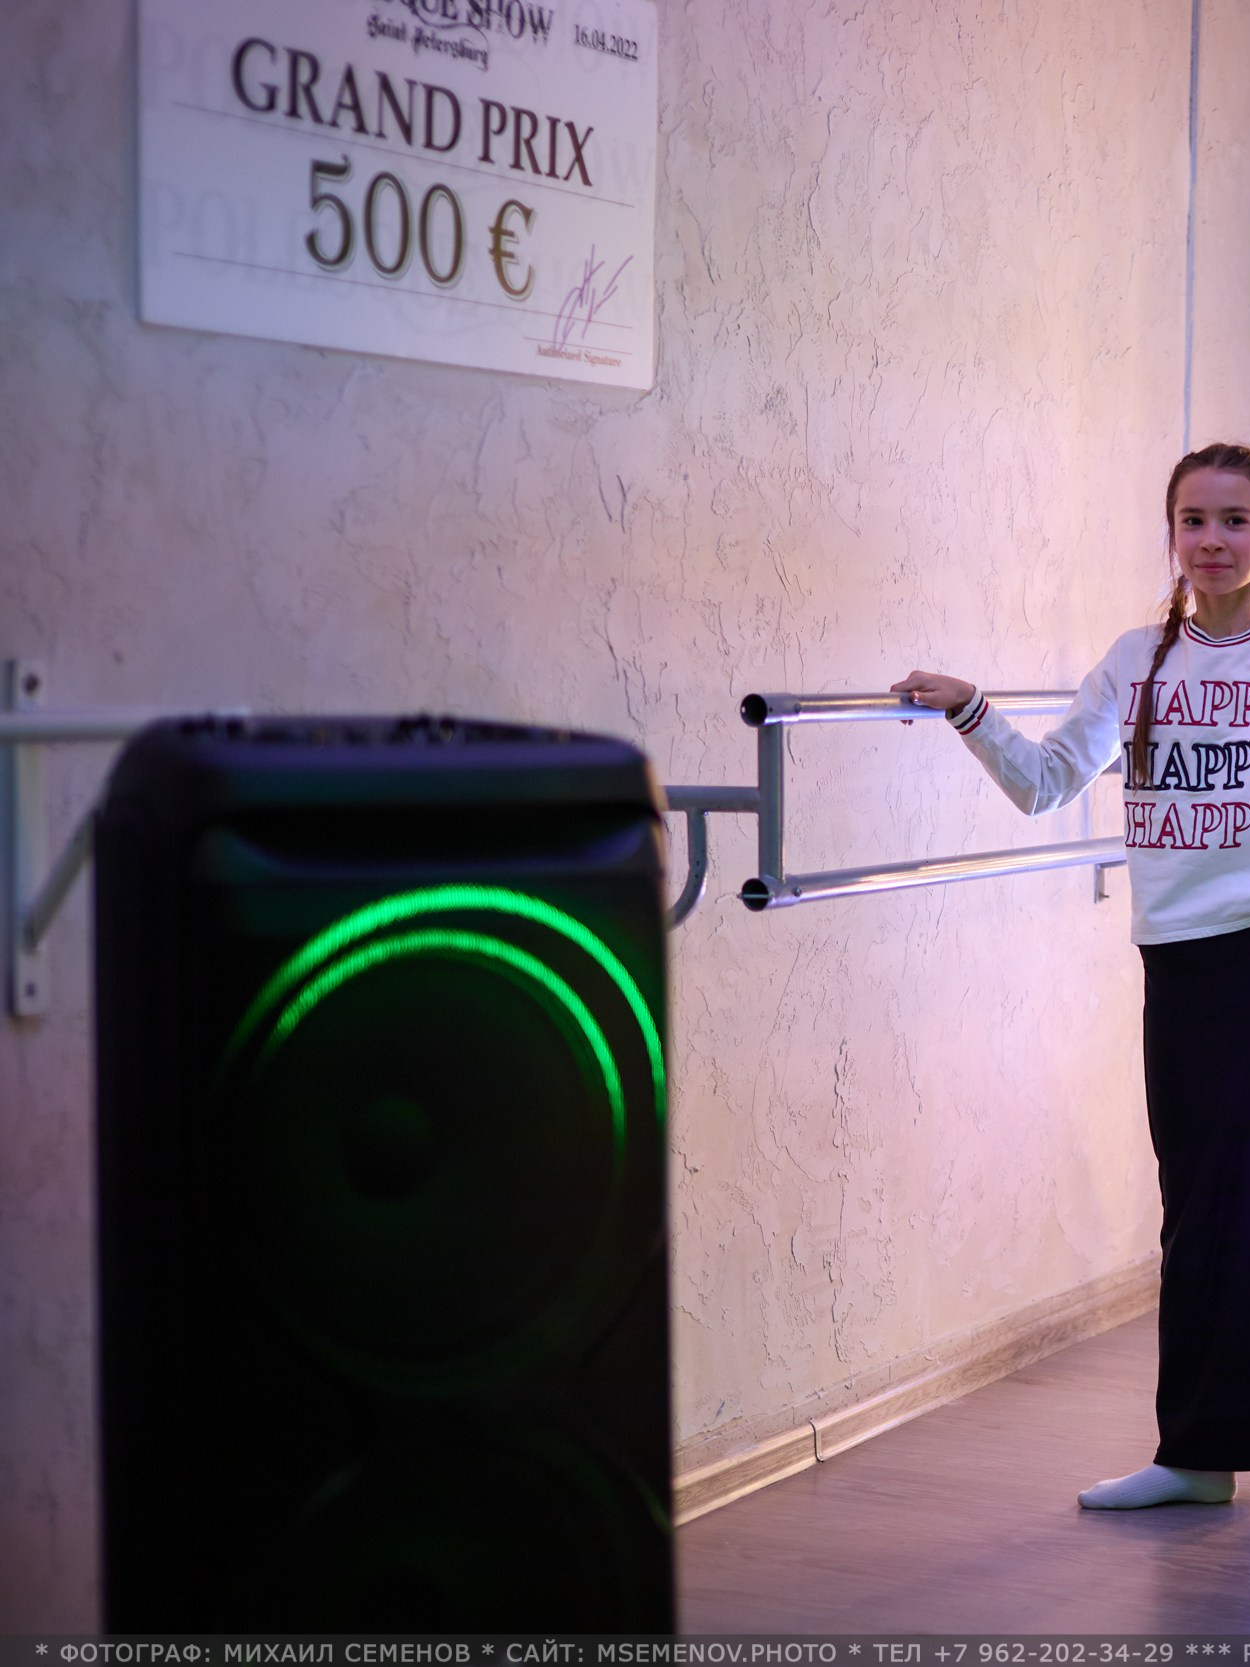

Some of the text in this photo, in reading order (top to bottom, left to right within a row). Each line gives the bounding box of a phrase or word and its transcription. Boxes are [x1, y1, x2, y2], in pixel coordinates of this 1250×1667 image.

[231, 37, 463, 153] GRAND
[478, 97, 595, 187] PRIX
[574, 23, 639, 62] 16.04.2022
[305, 154, 465, 287] 500
[488, 198, 538, 301] €
